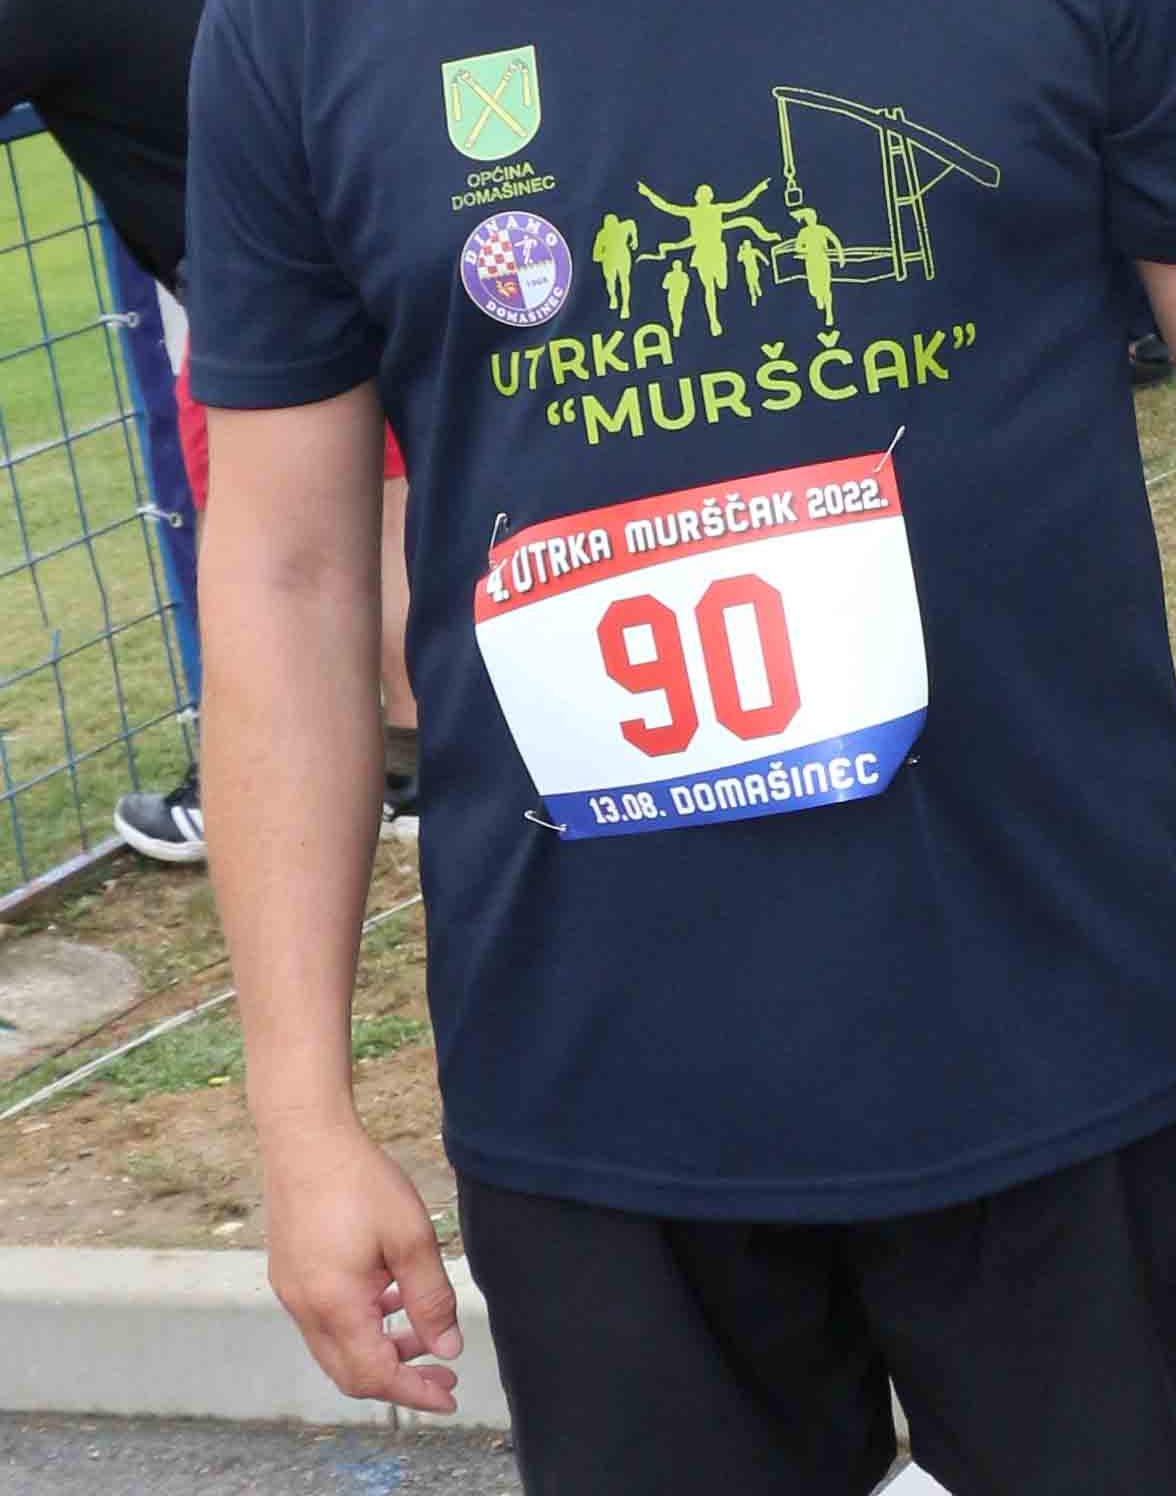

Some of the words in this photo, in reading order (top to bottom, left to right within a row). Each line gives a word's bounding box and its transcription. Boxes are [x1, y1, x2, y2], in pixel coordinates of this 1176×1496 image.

[451, 175, 556, 211] DOMAŠINEC
[467, 161, 535, 188] OPĆINA
[464, 215, 559, 265] DINAMO
[490, 324, 673, 397] UTRKA
[511, 528, 611, 593] UTRKA
[624, 491, 799, 555] MURŠČAK
[805, 478, 890, 516] 2022.
[596, 573, 802, 758] 90
[589, 795, 666, 825] 13.08.
[670, 751, 880, 817] DOMAŠINEC
